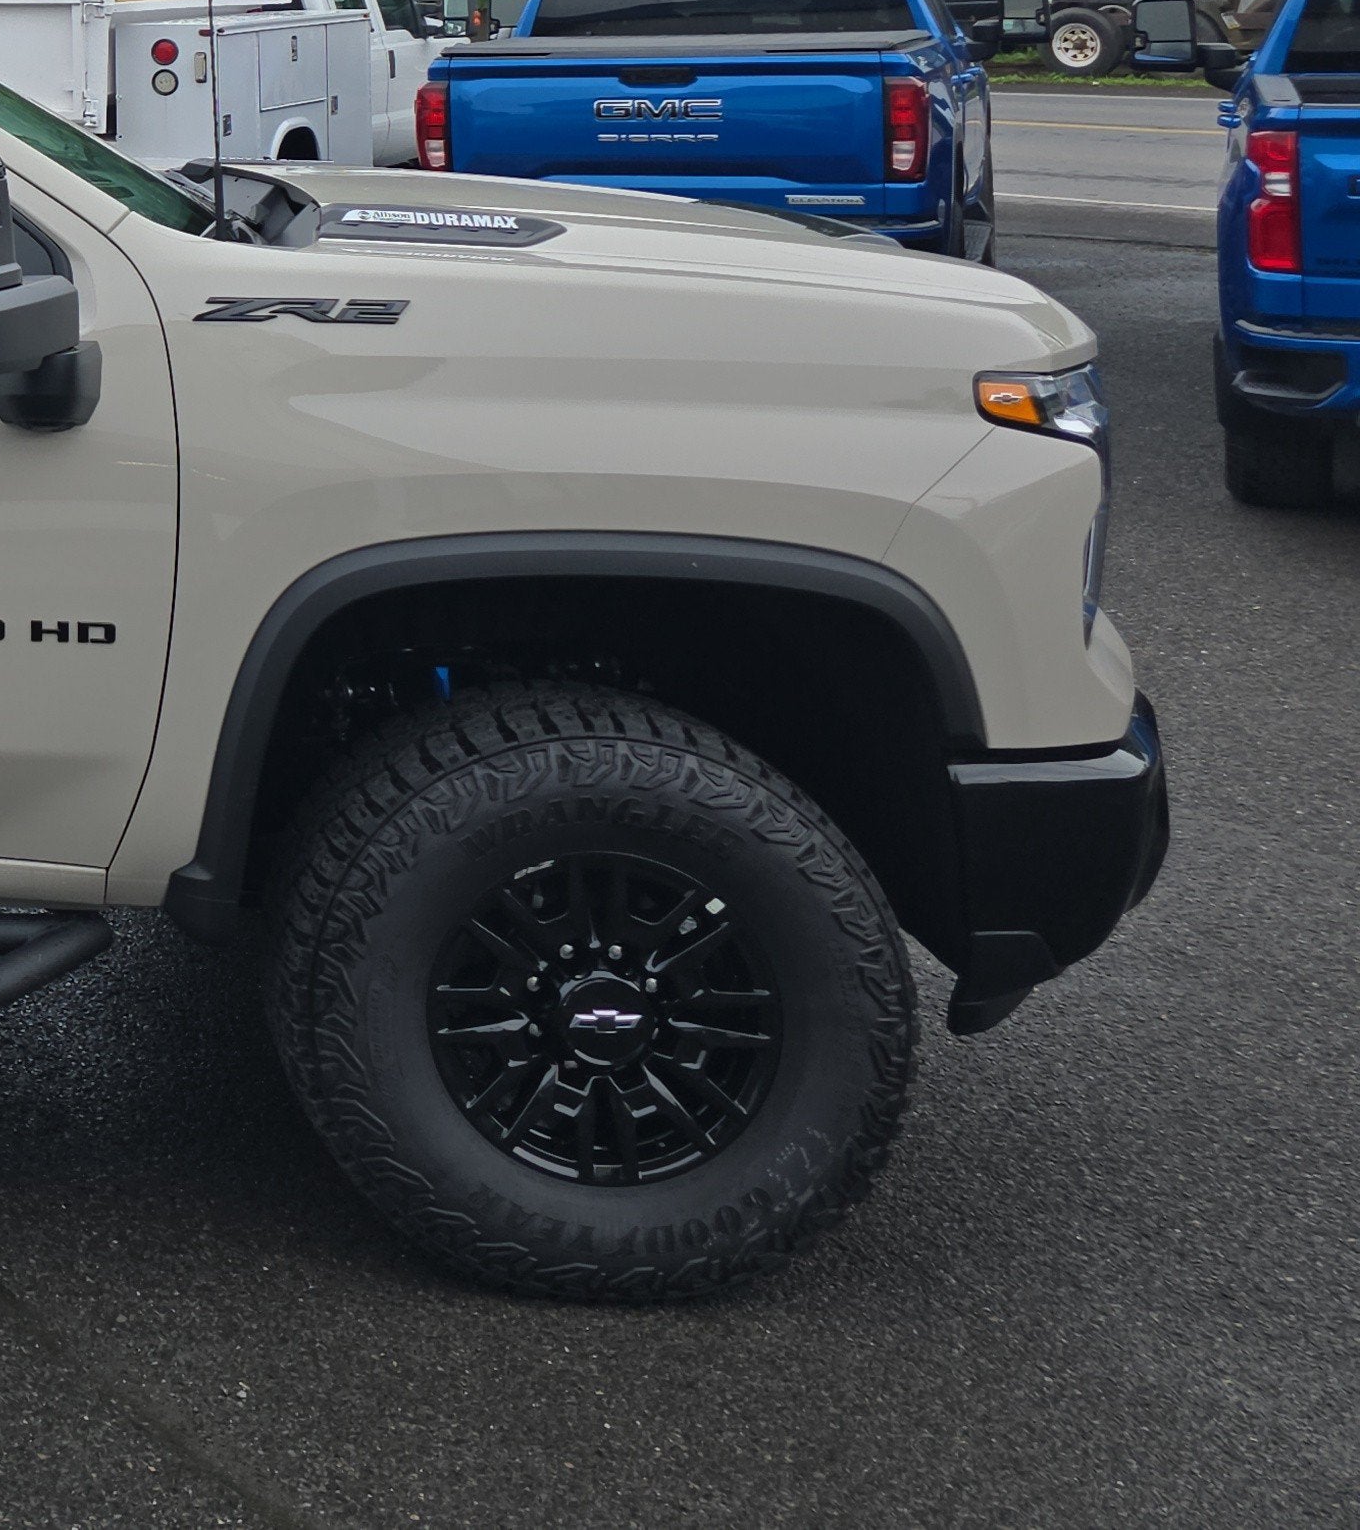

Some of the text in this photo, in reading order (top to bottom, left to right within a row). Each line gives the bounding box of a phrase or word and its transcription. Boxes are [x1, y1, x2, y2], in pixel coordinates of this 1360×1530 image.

[593, 98, 723, 121] GMC
[414, 211, 520, 230] DURAMAX
[192, 296, 411, 325] ZR2
[30, 619, 117, 644] HD
[458, 792, 750, 862] WRANGLER
